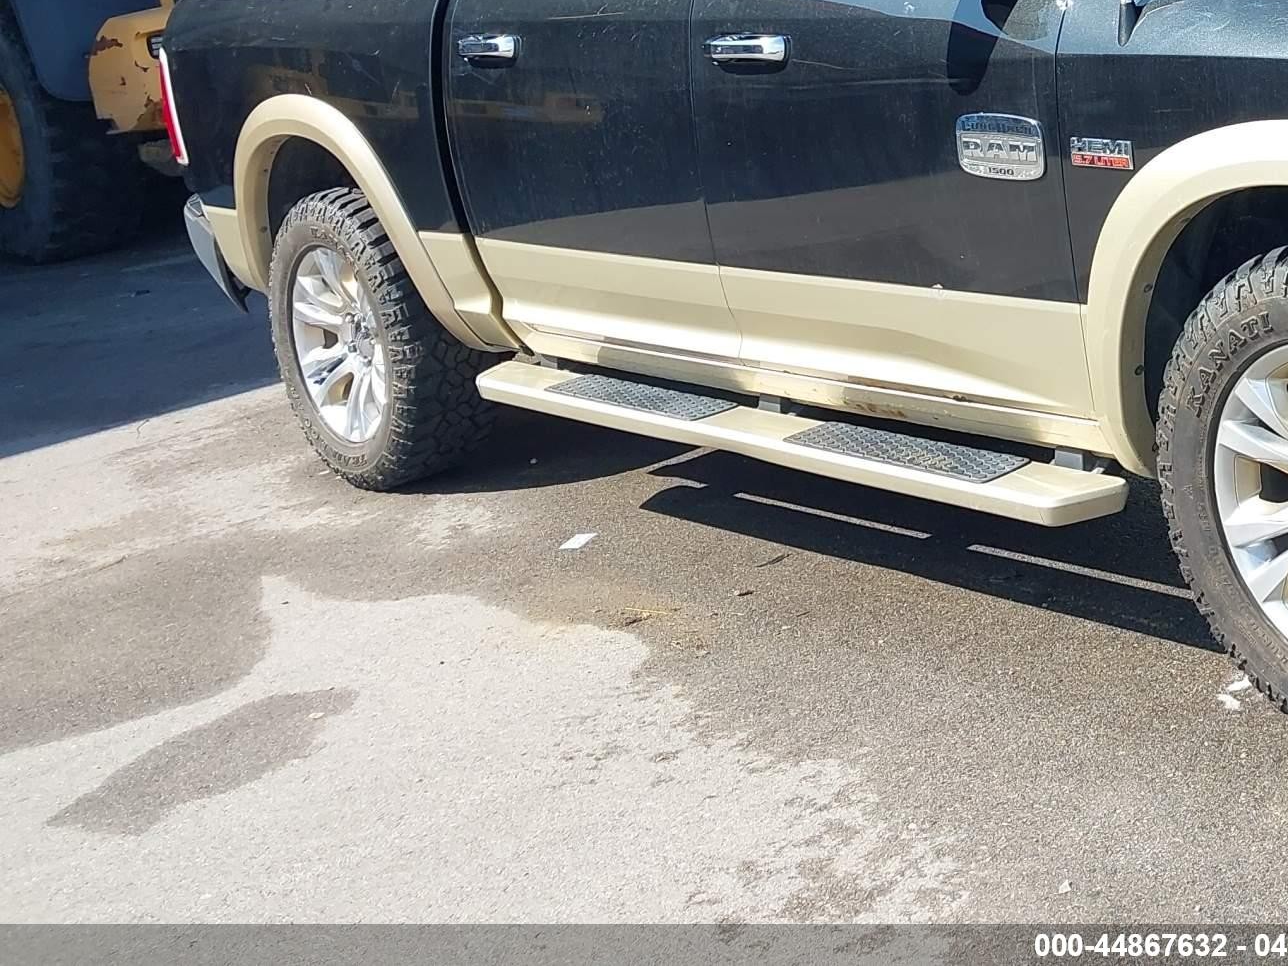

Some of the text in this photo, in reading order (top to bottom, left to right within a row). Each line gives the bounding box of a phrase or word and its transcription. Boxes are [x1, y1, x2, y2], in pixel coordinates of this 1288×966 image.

[962, 137, 1038, 163] RAM
[1071, 137, 1130, 156] HEMI
[1074, 154, 1129, 168] 5.7 LITER
[988, 166, 1015, 176] 1500
[1186, 311, 1275, 419] KANATI
